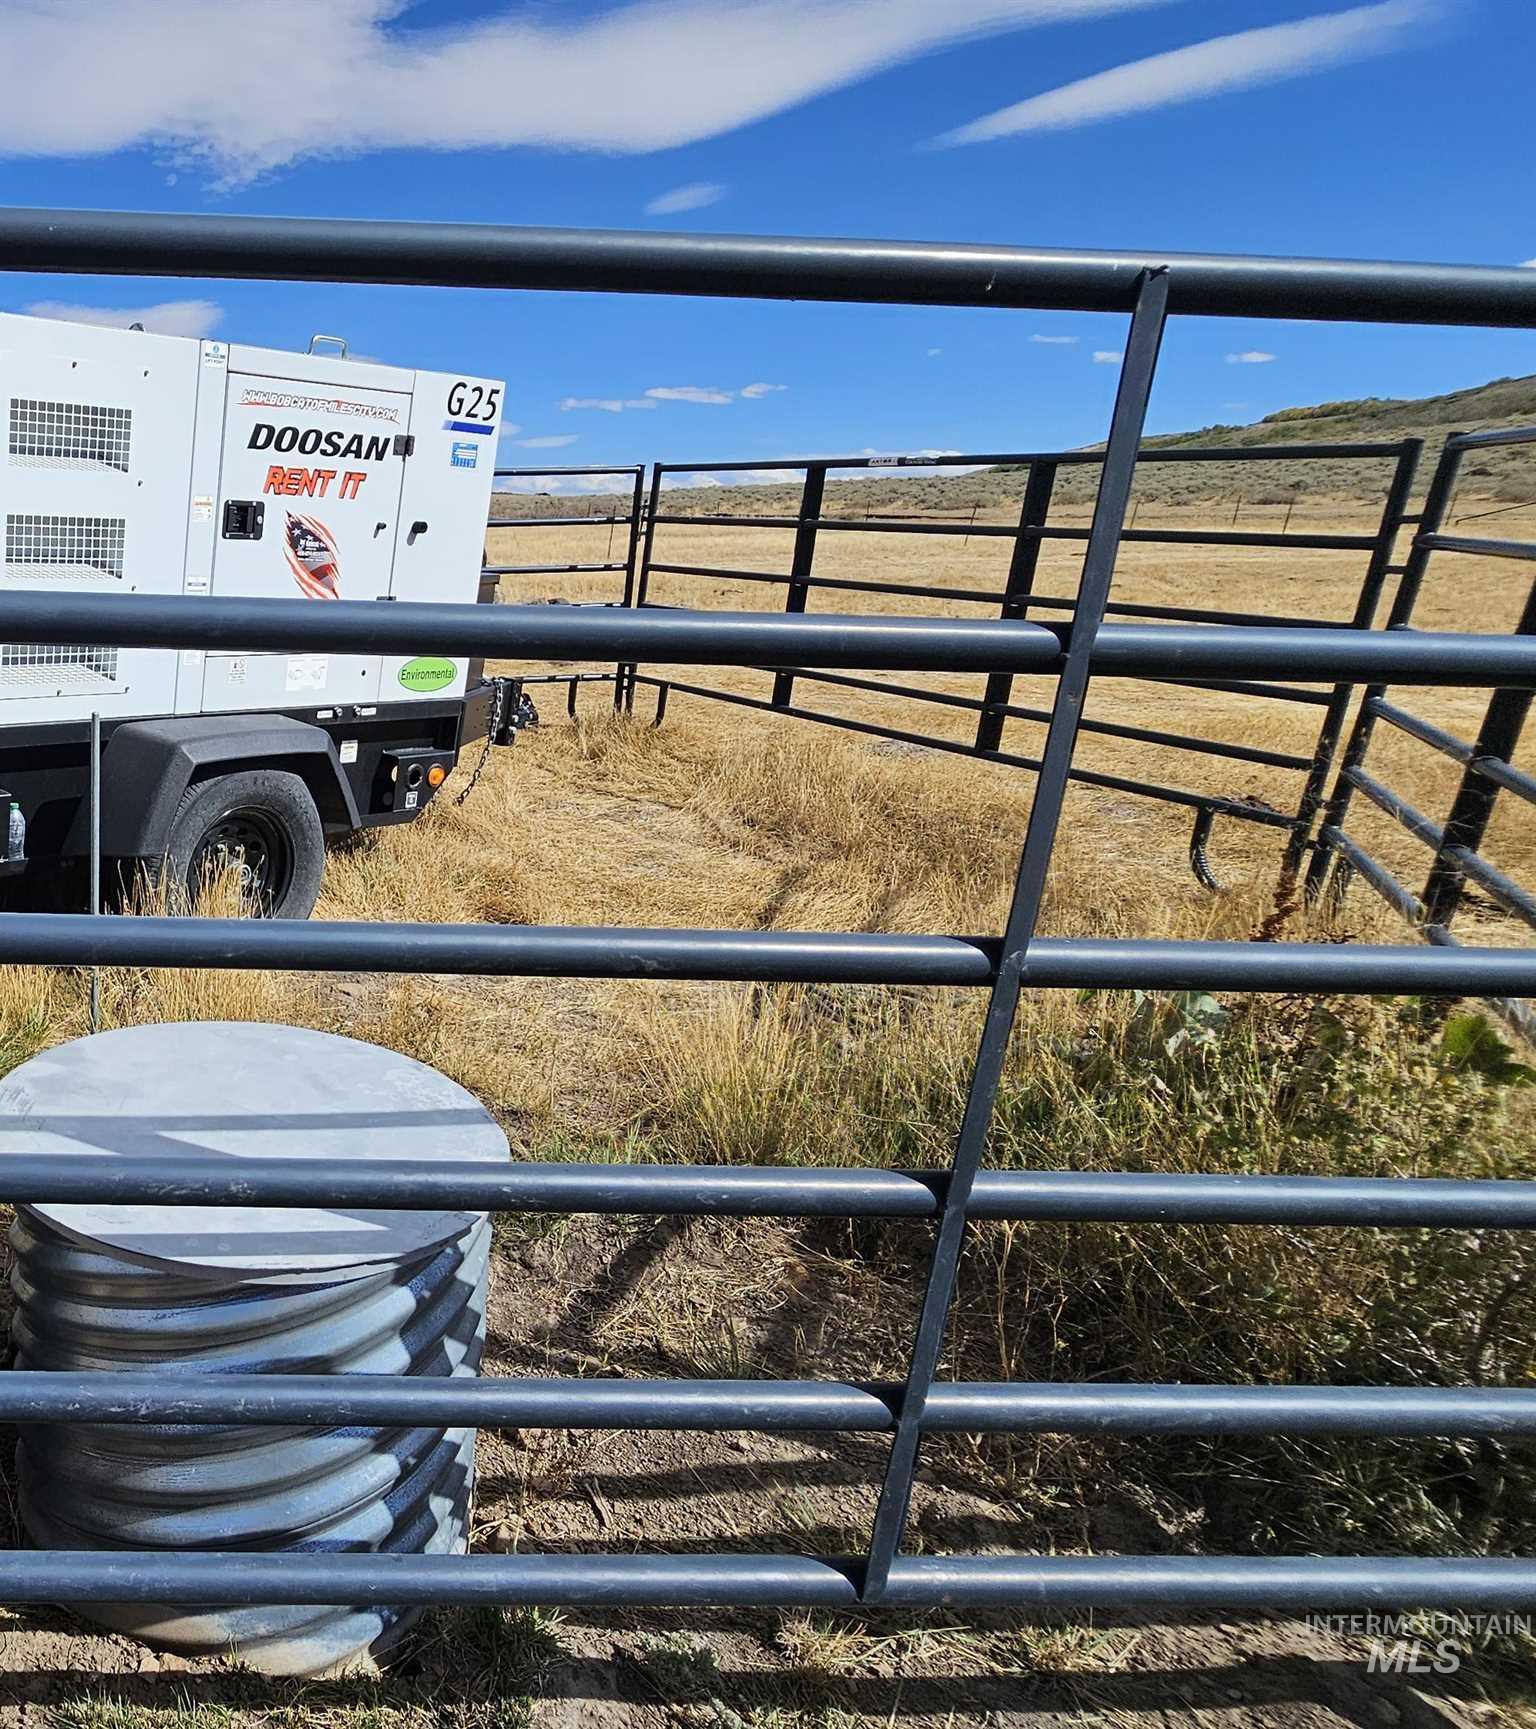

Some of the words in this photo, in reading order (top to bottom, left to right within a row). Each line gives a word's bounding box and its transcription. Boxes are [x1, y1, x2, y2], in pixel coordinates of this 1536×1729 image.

[447, 381, 501, 421] G25
[247, 423, 391, 461] DOOSAN
[263, 465, 337, 498] RENT
[339, 471, 368, 499] IT
[401, 668, 455, 681] Environmental
